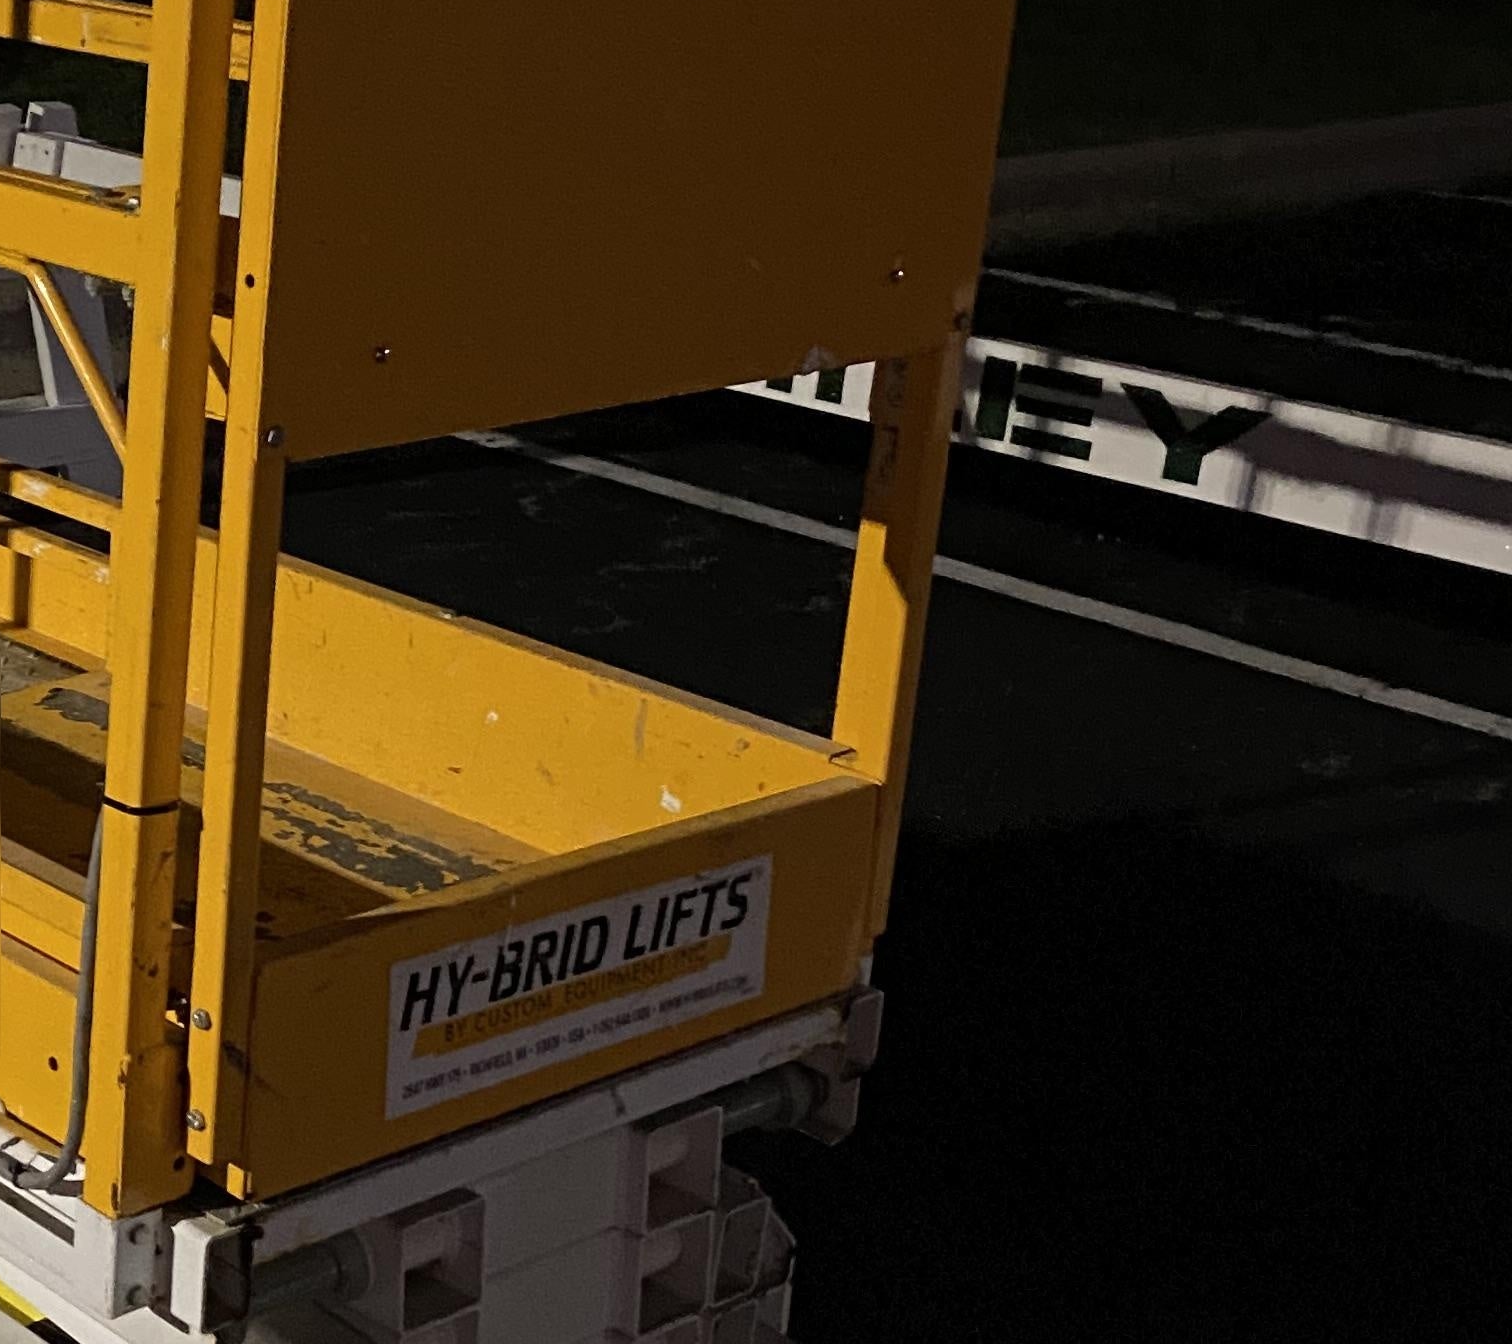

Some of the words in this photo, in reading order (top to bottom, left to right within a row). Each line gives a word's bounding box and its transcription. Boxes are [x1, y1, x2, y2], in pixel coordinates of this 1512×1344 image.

[399, 913, 610, 1032] HY-BRID
[623, 871, 754, 961] LIFTS
[444, 1019, 468, 1043] BY
[473, 992, 553, 1032] CUSTOM
[565, 953, 665, 1004] EQUIPMENT
